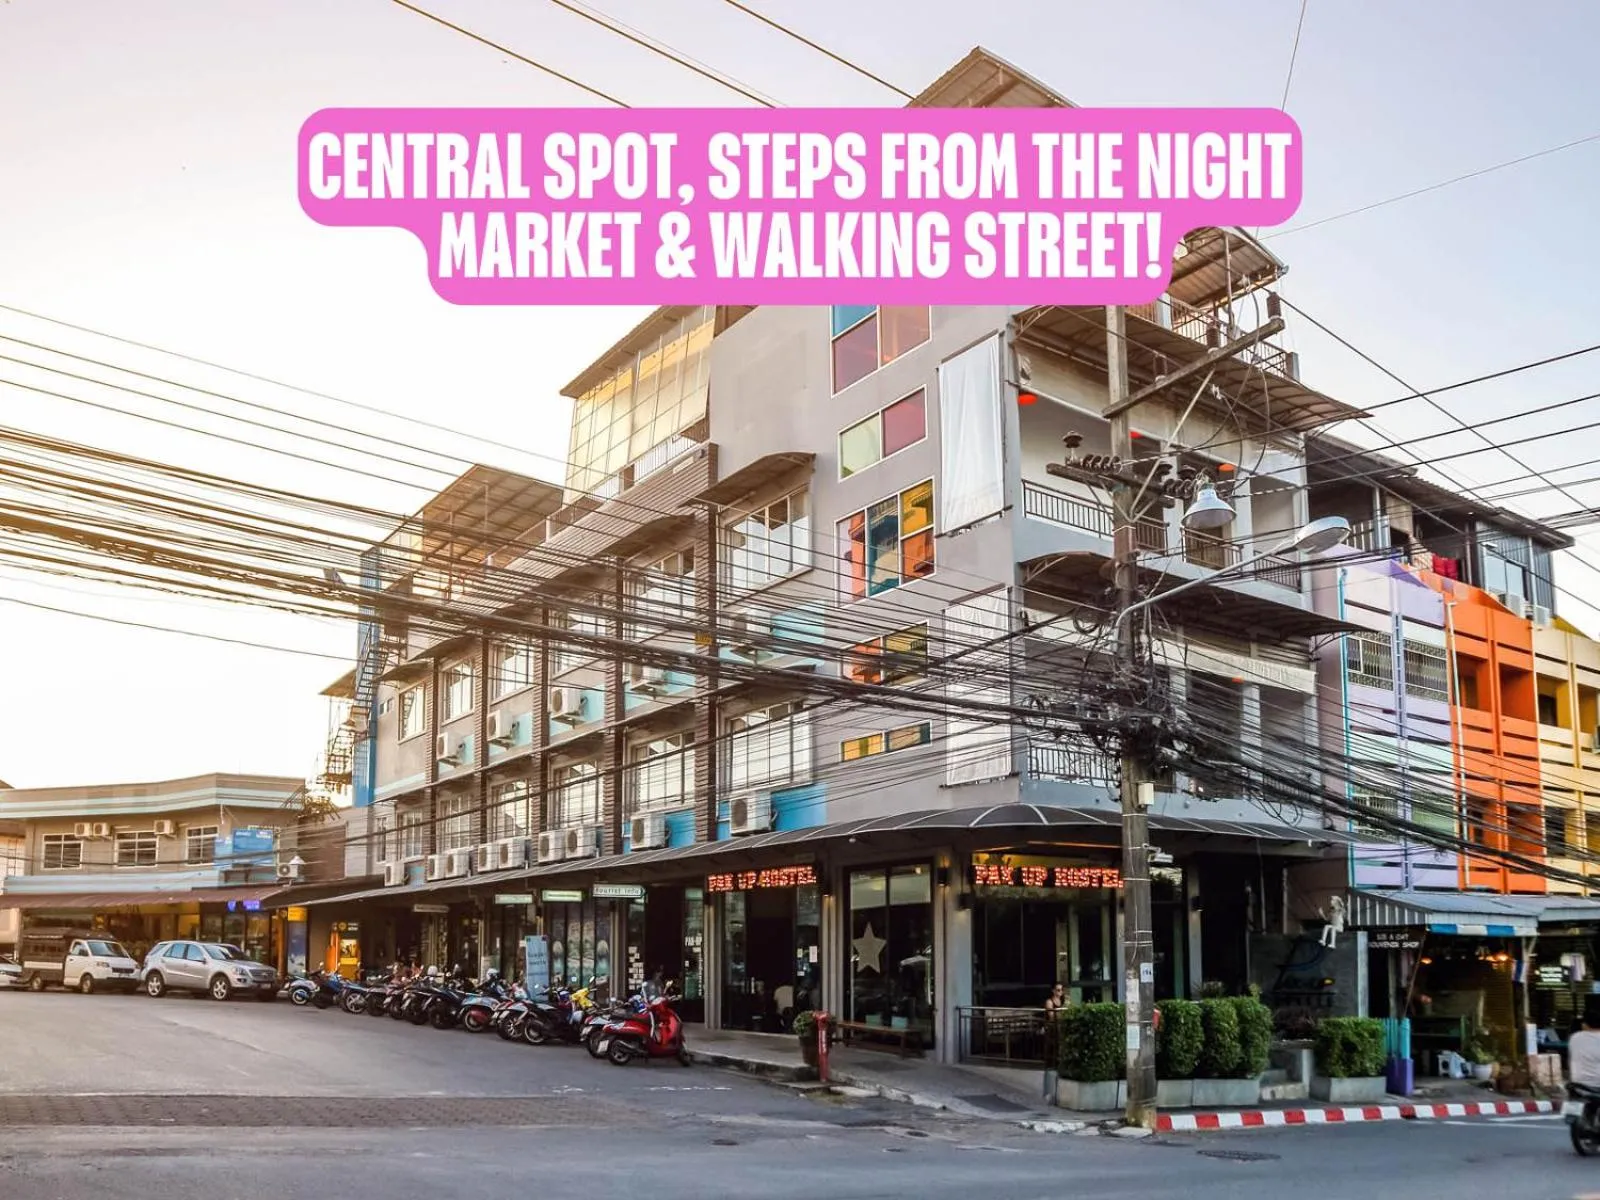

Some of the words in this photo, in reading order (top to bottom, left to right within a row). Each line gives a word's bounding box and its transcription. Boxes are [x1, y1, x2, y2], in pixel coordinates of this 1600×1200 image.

[737, 871, 757, 889] UP
[760, 866, 817, 887] HOSTEL
[1021, 866, 1048, 886] UP
[1054, 867, 1124, 888] HOSTEL
